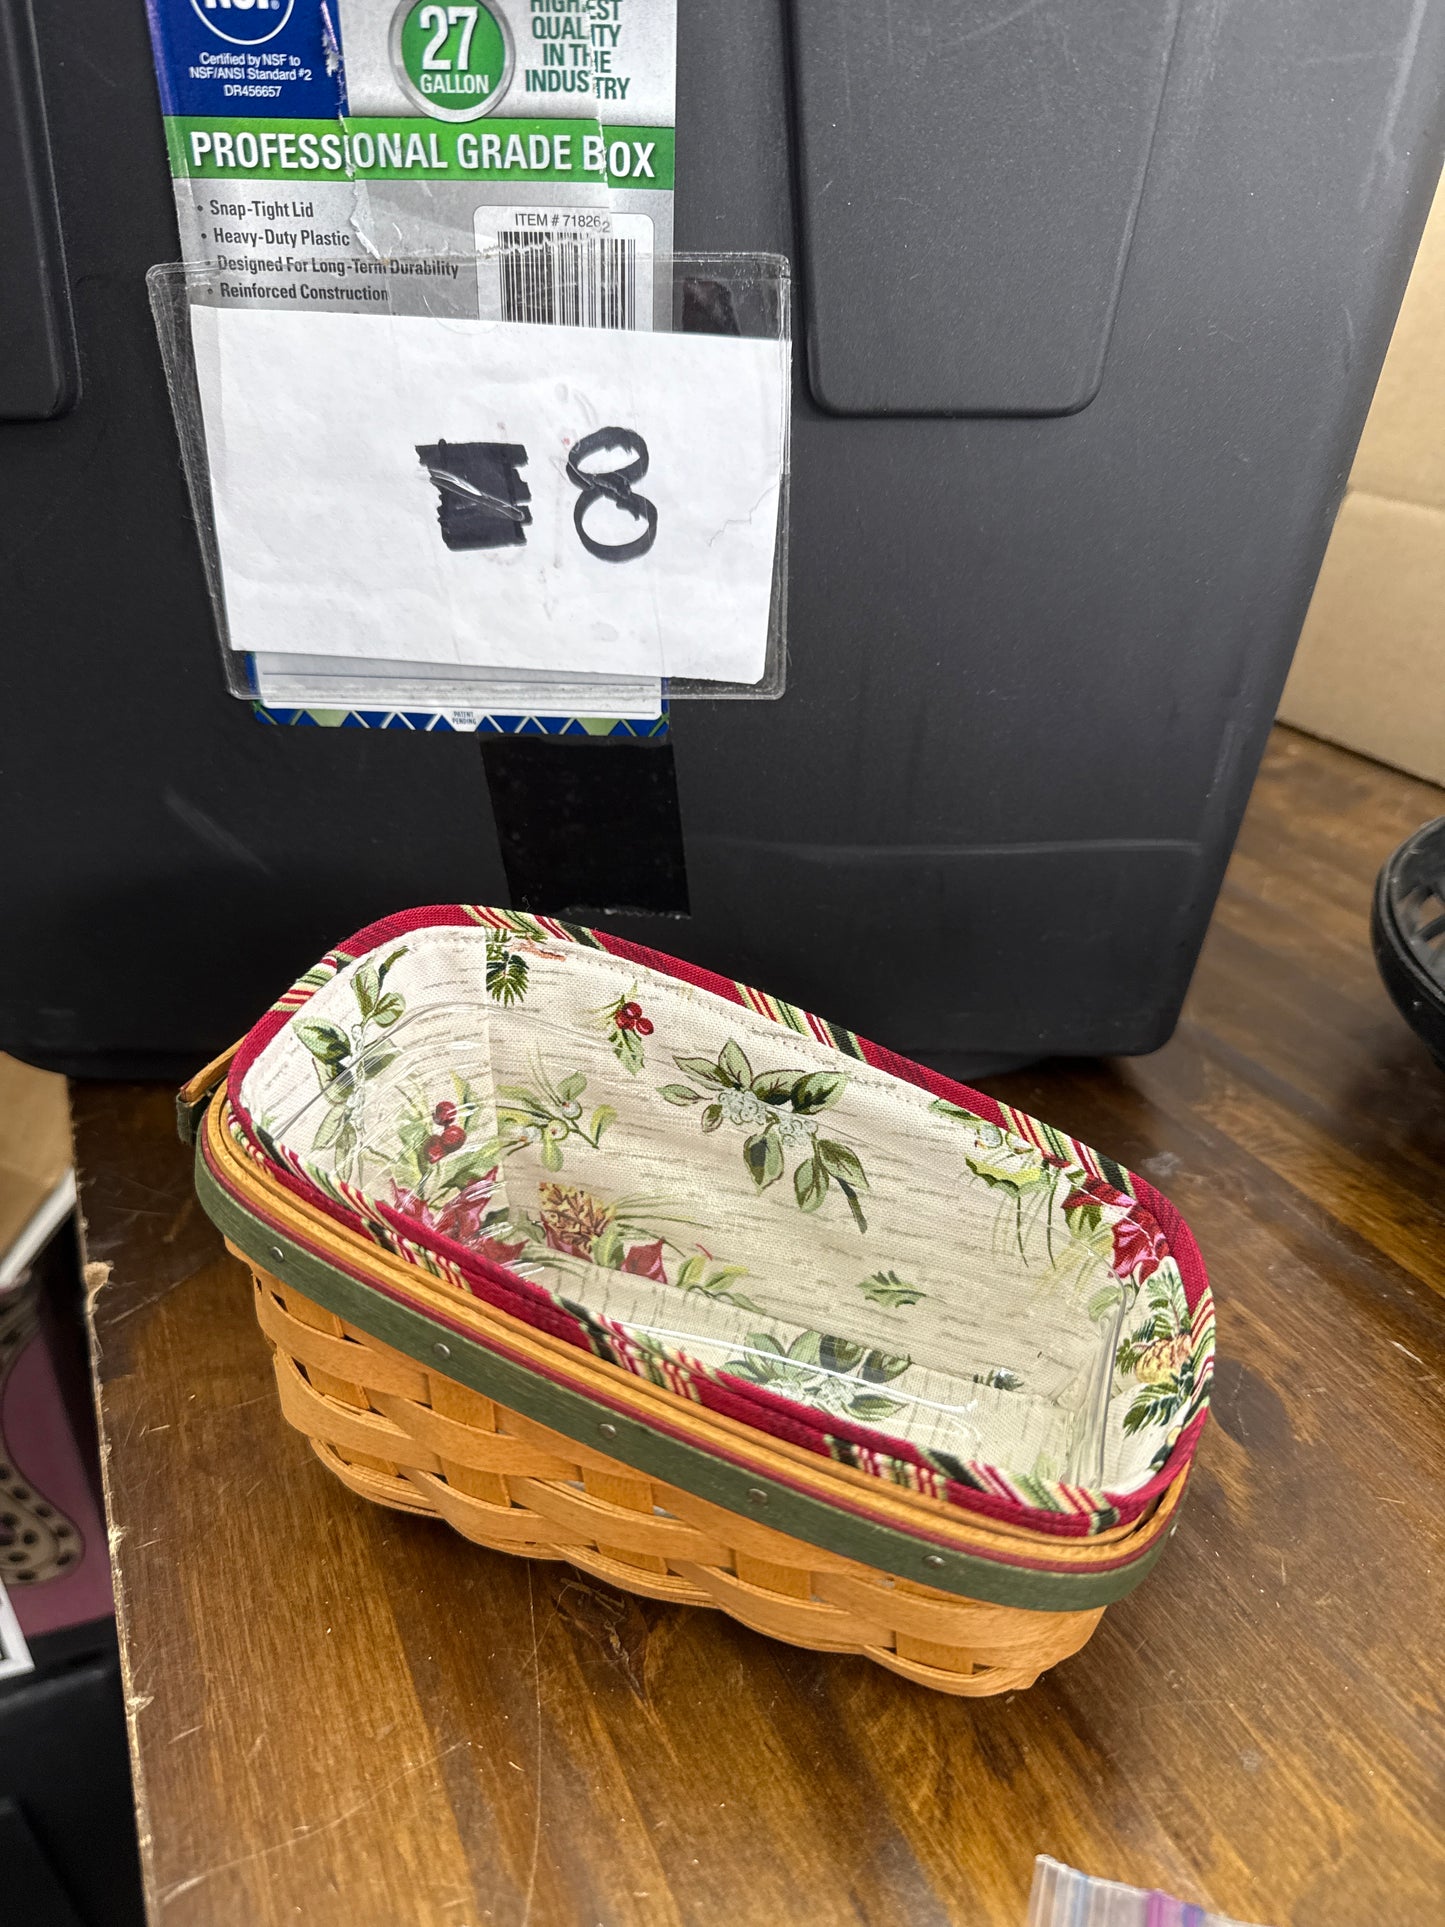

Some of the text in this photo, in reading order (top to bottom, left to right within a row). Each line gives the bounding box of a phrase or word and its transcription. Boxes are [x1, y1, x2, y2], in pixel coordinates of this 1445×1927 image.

[419, 5, 479, 71] 27
[532, 16, 622, 47] QUALITY
[199, 52, 301, 68] Certified by NSF to
[543, 43, 611, 73] IN THE
[189, 66, 245, 79] NSF/ANSI
[247, 67, 297, 80] Standard
[223, 84, 282, 97] DR456657
[420, 74, 489, 95] GALLON
[525, 69, 631, 100] INDUSTRY
[190, 131, 655, 178] PROFESSIONAL GRADE BOX
[210, 200, 314, 220] Snap-Tight Lid
[515, 213, 547, 226] ITEM
[551, 214, 559, 226] #
[213, 227, 350, 248] Heavy-Duty Plastic
[217, 255, 282, 275] Designed
[287, 256, 308, 272] For
[390, 260, 459, 279] Durability
[220, 282, 388, 301] Reinforced Construction
[566, 426, 658, 563] 8
